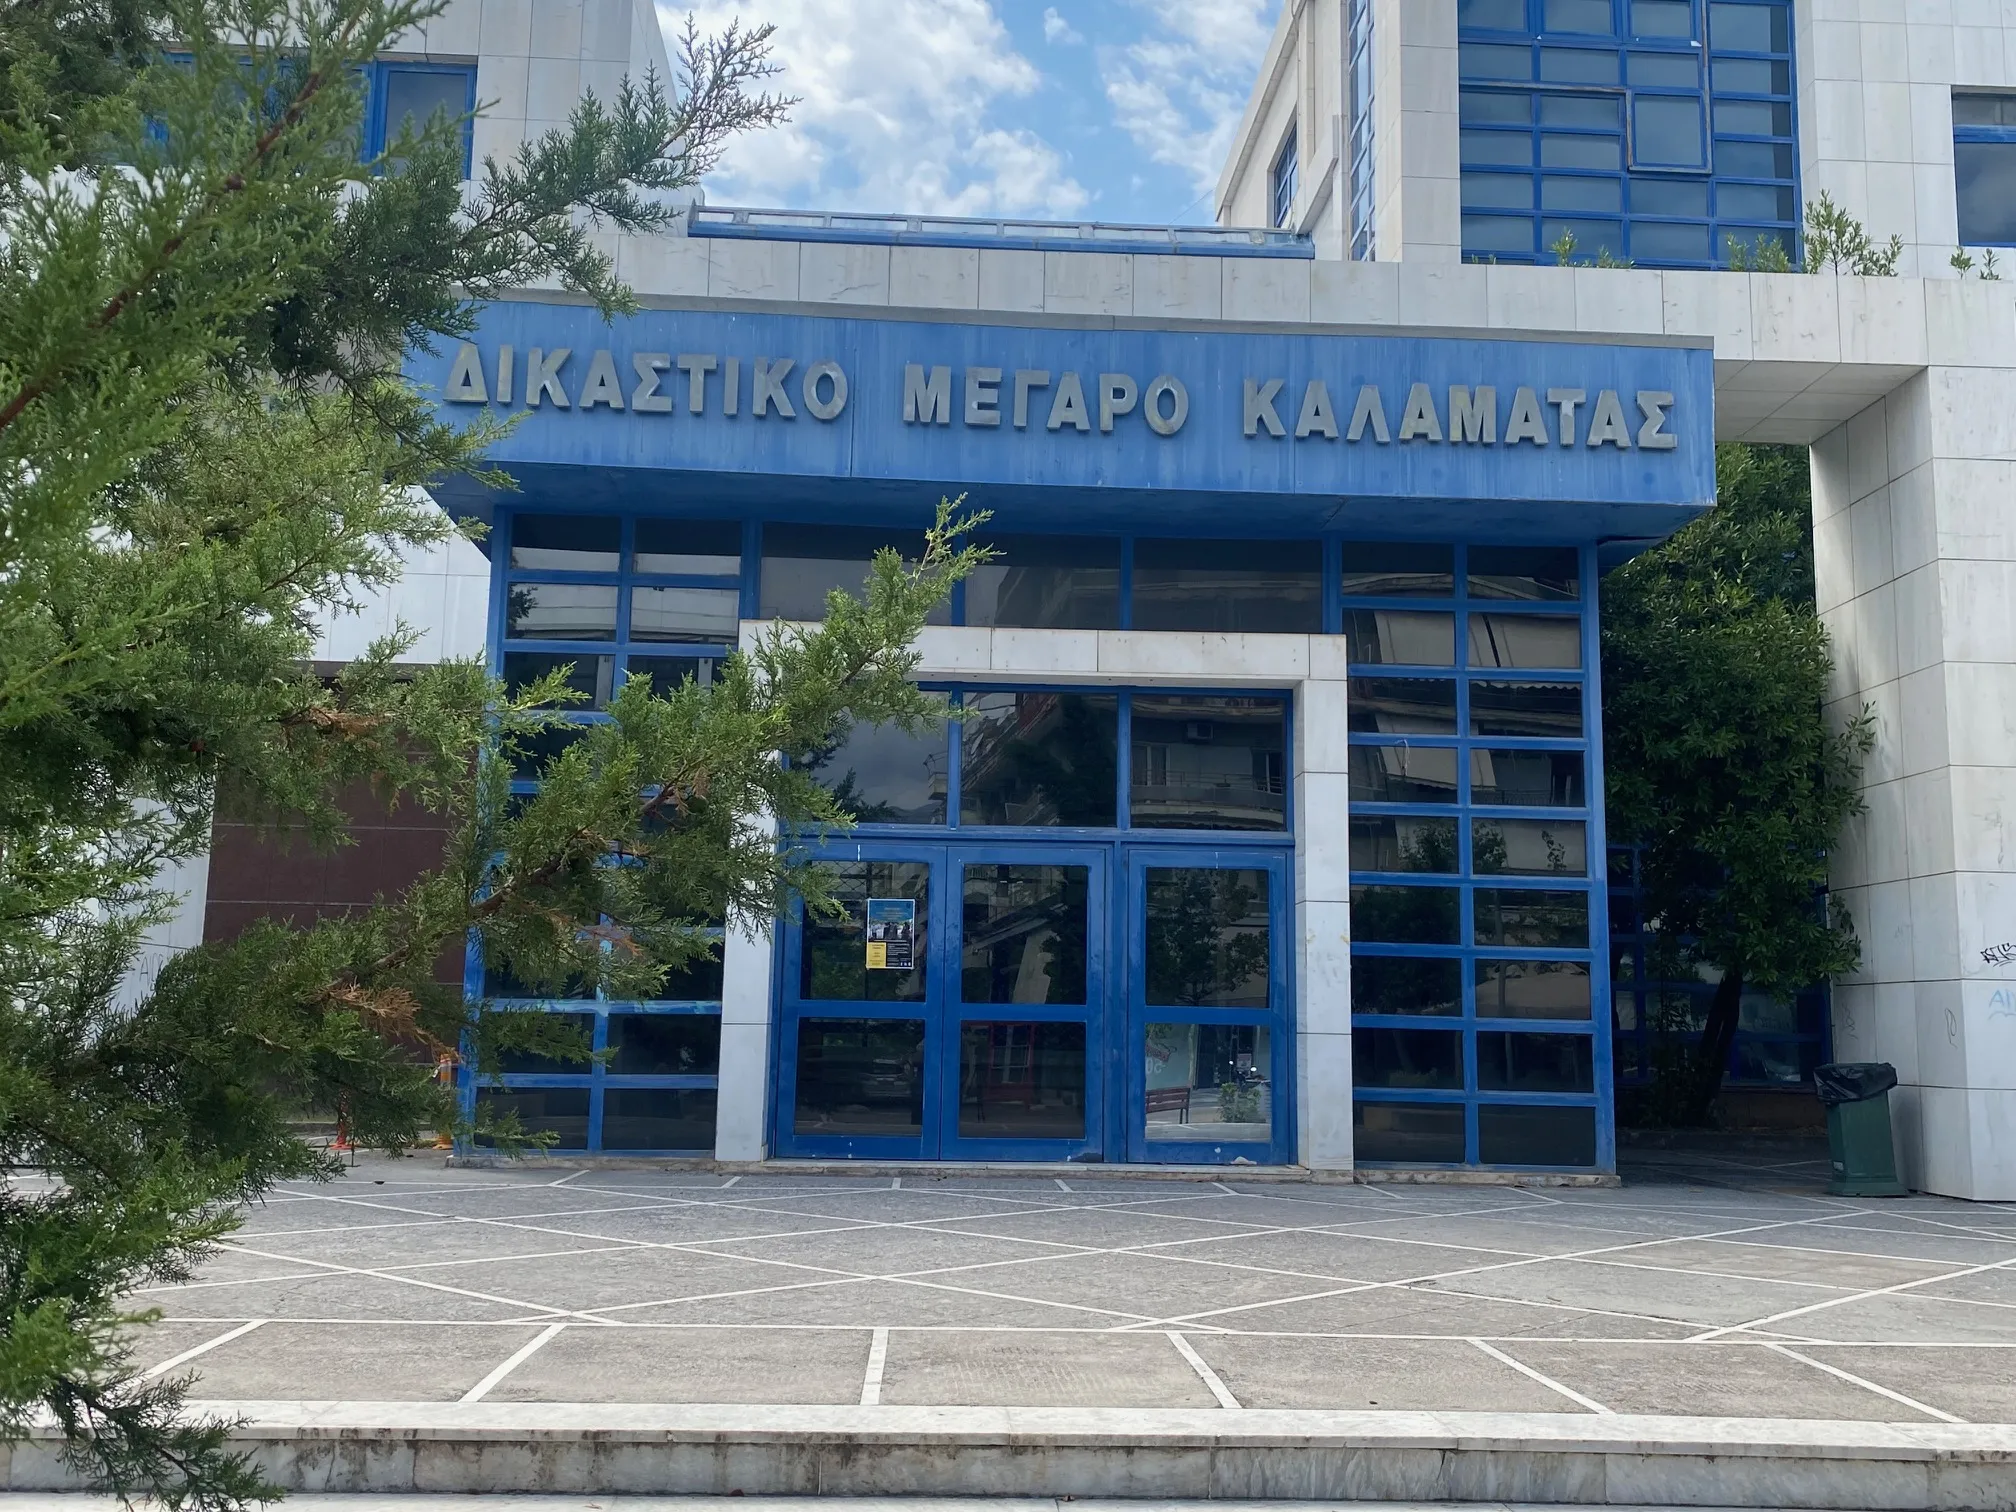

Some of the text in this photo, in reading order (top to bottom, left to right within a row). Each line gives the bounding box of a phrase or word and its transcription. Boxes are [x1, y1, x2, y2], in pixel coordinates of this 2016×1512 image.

[443, 343, 1678, 449] ΔΙΚΑΣΤΙΚΟ ΜΕΓΑΡΟ ΚΑΛΑΜΑΤΑΣ
